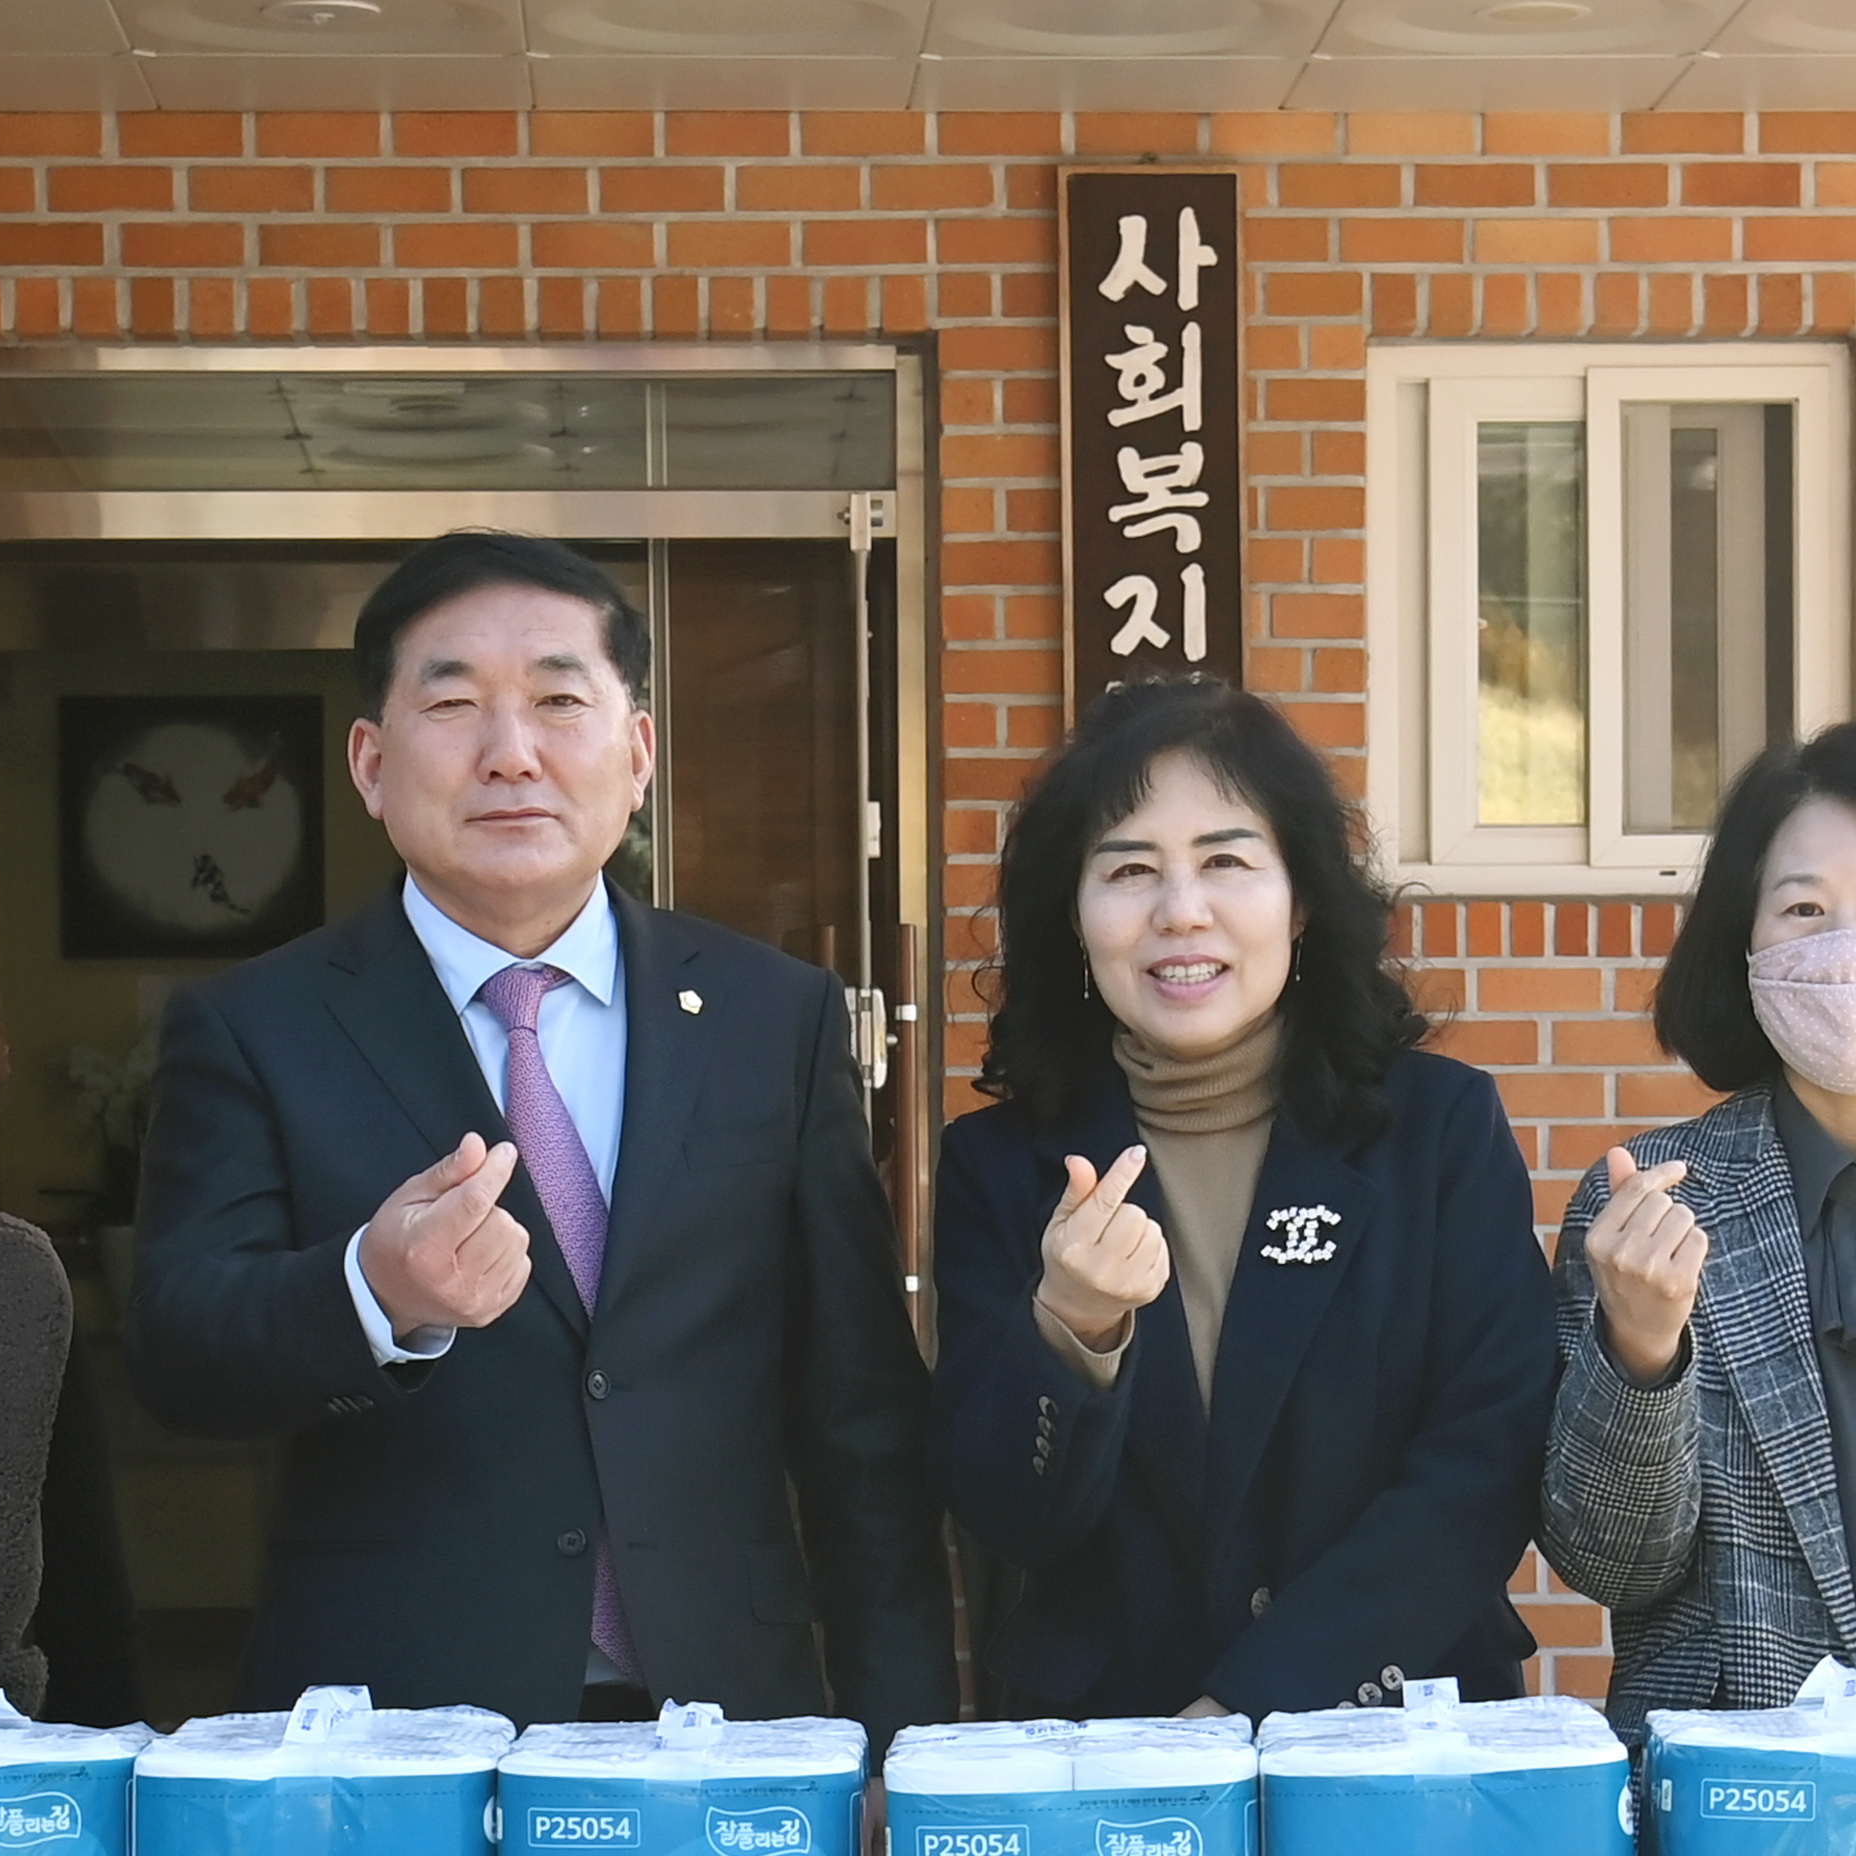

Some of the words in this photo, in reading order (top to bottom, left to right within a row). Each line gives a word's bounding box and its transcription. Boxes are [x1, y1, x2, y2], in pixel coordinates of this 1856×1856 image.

[1098, 206, 1219, 693] 사회복지
[1709, 1789, 1806, 1812] P25054
[536, 1817, 632, 1841] P25054
[715, 1819, 802, 1854] 잘풀리는집
